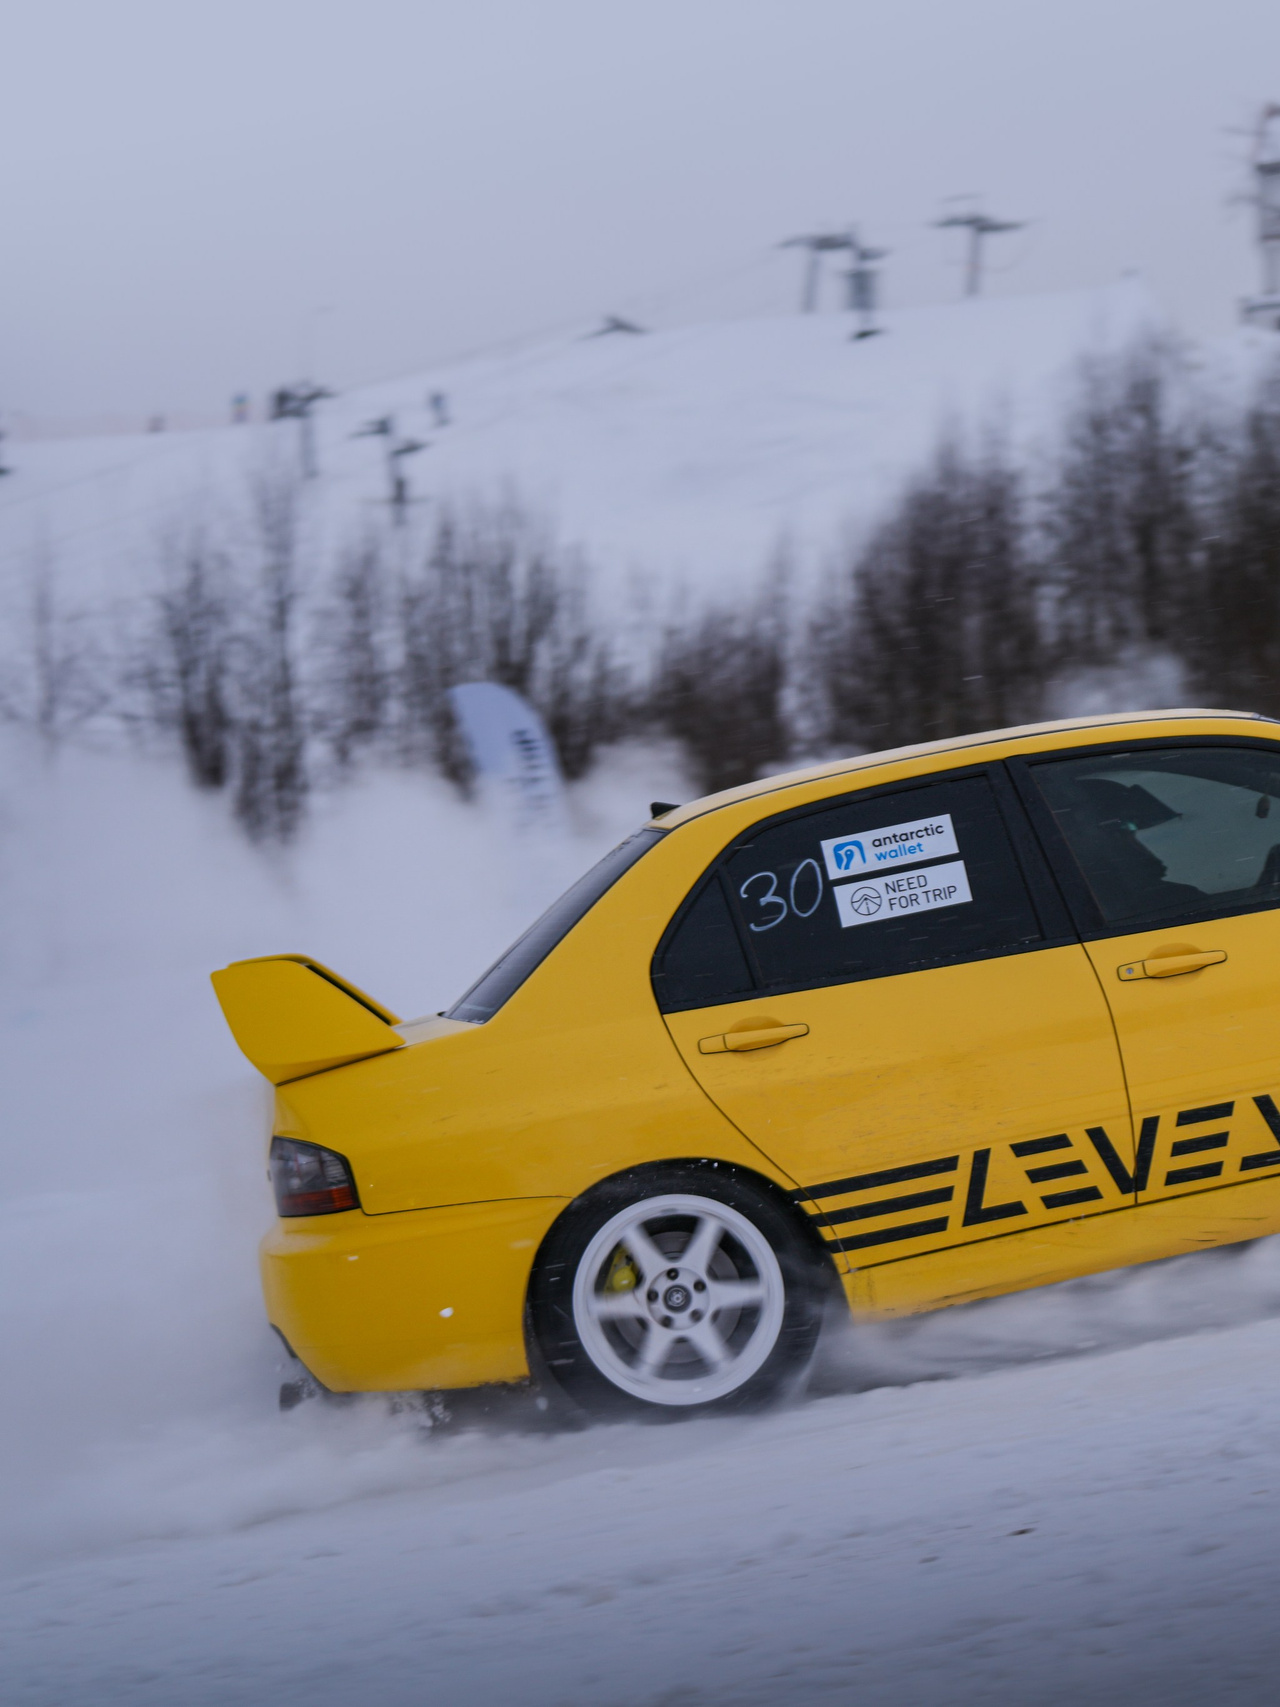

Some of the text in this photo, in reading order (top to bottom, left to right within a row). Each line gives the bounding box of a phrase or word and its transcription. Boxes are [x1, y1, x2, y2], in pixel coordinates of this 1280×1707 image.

[872, 823, 944, 848] antarctic
[875, 842, 923, 861] wallet
[740, 858, 822, 931] 30
[885, 874, 928, 895] NEED
[889, 885, 957, 911] FOR TRIP
